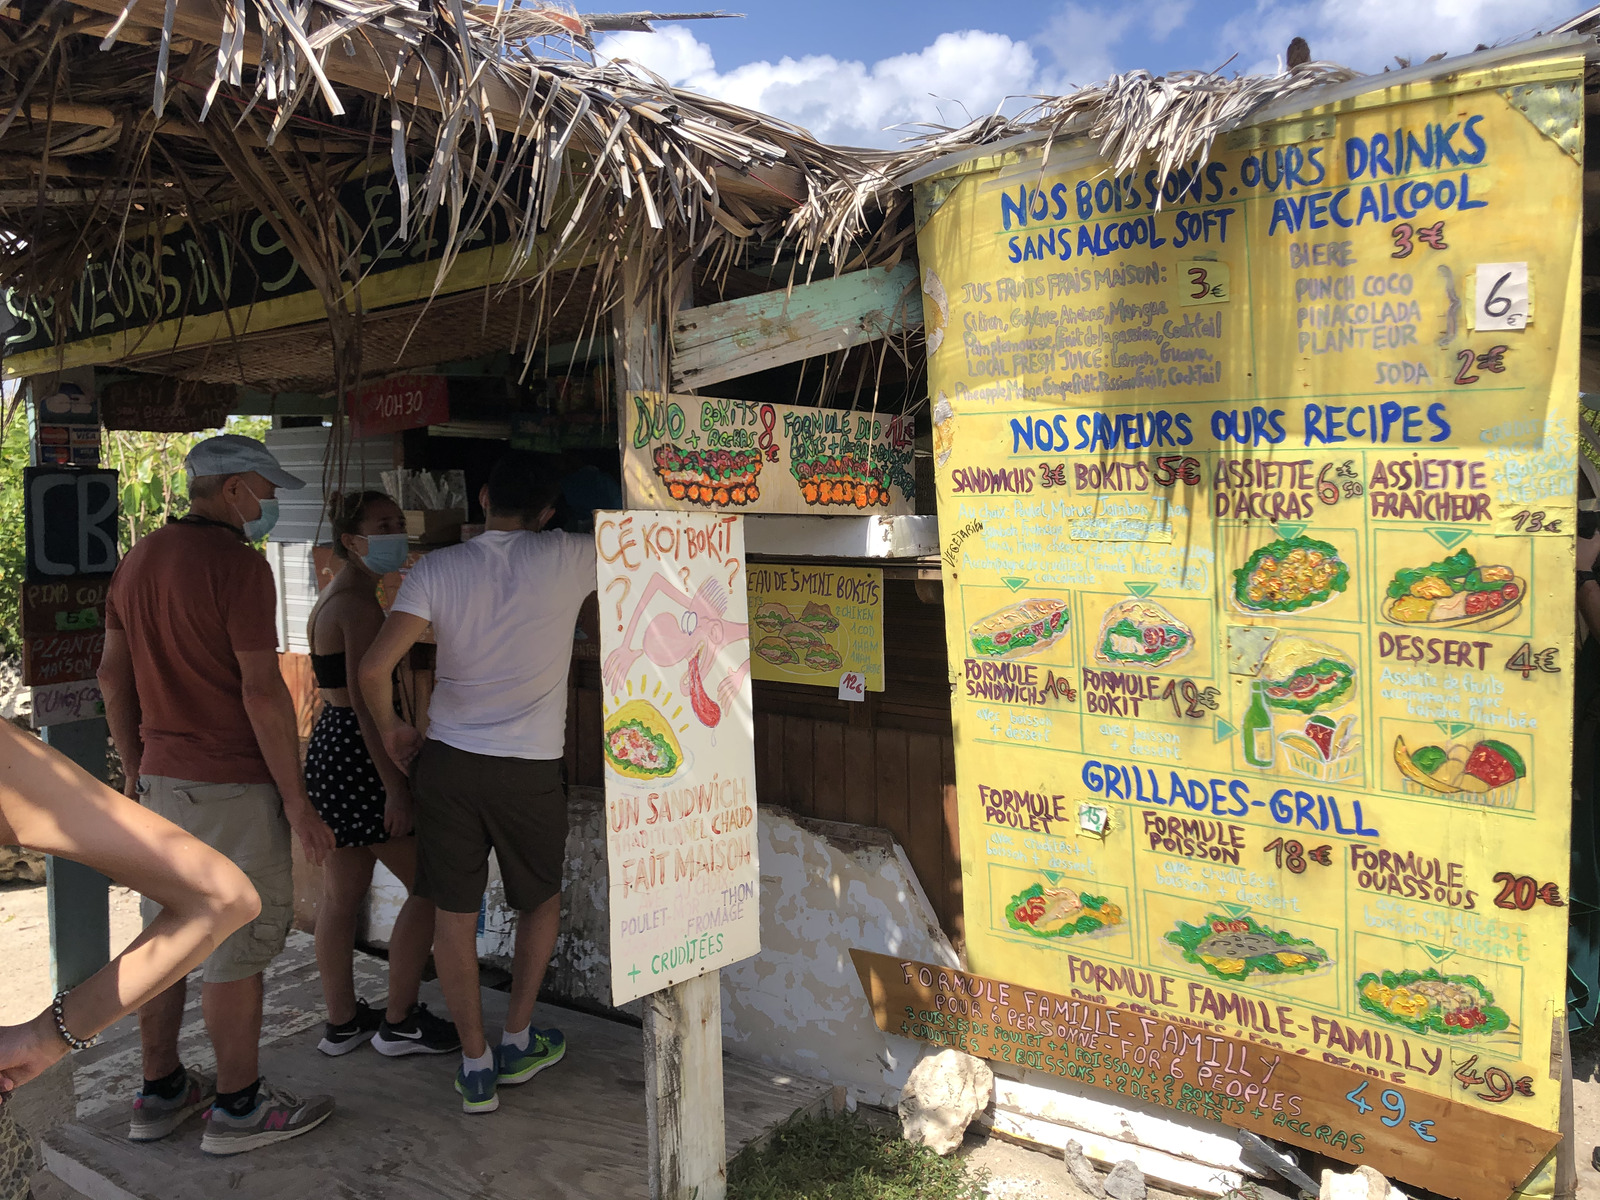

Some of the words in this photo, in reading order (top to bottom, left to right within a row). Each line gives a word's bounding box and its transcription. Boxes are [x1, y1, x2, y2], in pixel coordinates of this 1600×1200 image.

[1001, 182, 1067, 231] NOS
[1240, 147, 1325, 192] OURS
[1345, 115, 1488, 180] DRINKS
[1268, 188, 1354, 236] AVEC
[1355, 173, 1488, 226] ALCOOL
[1008, 228, 1072, 263] SANS
[1076, 215, 1166, 256] ALCOOL
[1173, 208, 1235, 248] SOFT
[1289, 240, 1357, 269] BIERE
[961, 281, 992, 304] JUS
[997, 276, 1045, 303] FRUITS
[1295, 276, 1355, 302] PUNCH
[1363, 273, 1413, 296] COCO
[1298, 324, 1418, 354] PLANTEUR
[966, 357, 1010, 377] LOCAL
[1012, 352, 1056, 377] FRESH
[1375, 362, 1433, 385] SODA
[633, 396, 686, 449] DUO
[707, 428, 756, 448] ACCRAS
[783, 410, 852, 438] FORMULE
[1010, 410, 1070, 454] NOS
[1073, 410, 1193, 453] SAVEURS
[1211, 405, 1286, 447] OURS
[1303, 402, 1452, 447] RECIPES
[1074, 460, 1149, 492] BOKITS
[1154, 455, 1201, 487] 5€
[1213, 458, 1315, 491] ASSIETTE
[1369, 452, 1487, 490] ASSIETTE
[1215, 490, 1314, 520] D'ACCRAS
[1371, 491, 1492, 523] FRAÎCHEUR
[30, 474, 119, 576] CB
[774, 571, 788, 591] DE
[790, 570, 800, 591] 5
[801, 572, 834, 596] MINI
[836, 575, 880, 606] BOKITS
[1378, 632, 1493, 670] DESSERT
[963, 658, 1038, 686] FORMULE
[1082, 667, 1162, 701] FORMULE
[1087, 690, 1143, 717] BOKIT
[610, 796, 640, 833] UN
[711, 805, 754, 835] CHAUD
[978, 784, 1069, 823] FORMULE
[986, 806, 1051, 835] POULET
[1142, 810, 1246, 848] FORMULE
[1150, 834, 1240, 865] POISSON
[1350, 844, 1464, 889] FORMULE
[721, 880, 754, 907] THON
[1358, 870, 1479, 910] OUASSOUS
[621, 907, 668, 938] POULET
[687, 901, 744, 937] FROMAGE
[900, 961, 1010, 1007] FORMULE
[1067, 955, 1178, 1007] FORMULE
[935, 994, 983, 1020] POUR
[990, 1005, 1001, 1025] 6
[1120, 1039, 1162, 1072] FOR
[1170, 1057, 1185, 1080] 6
[1197, 1065, 1303, 1117] PEOPLES
[972, 1021, 989, 1037] DE
[993, 1026, 1043, 1048] POULET
[1181, 1082, 1246, 1115] BOKITS
[1273, 1111, 1365, 1155] ACCRAS
